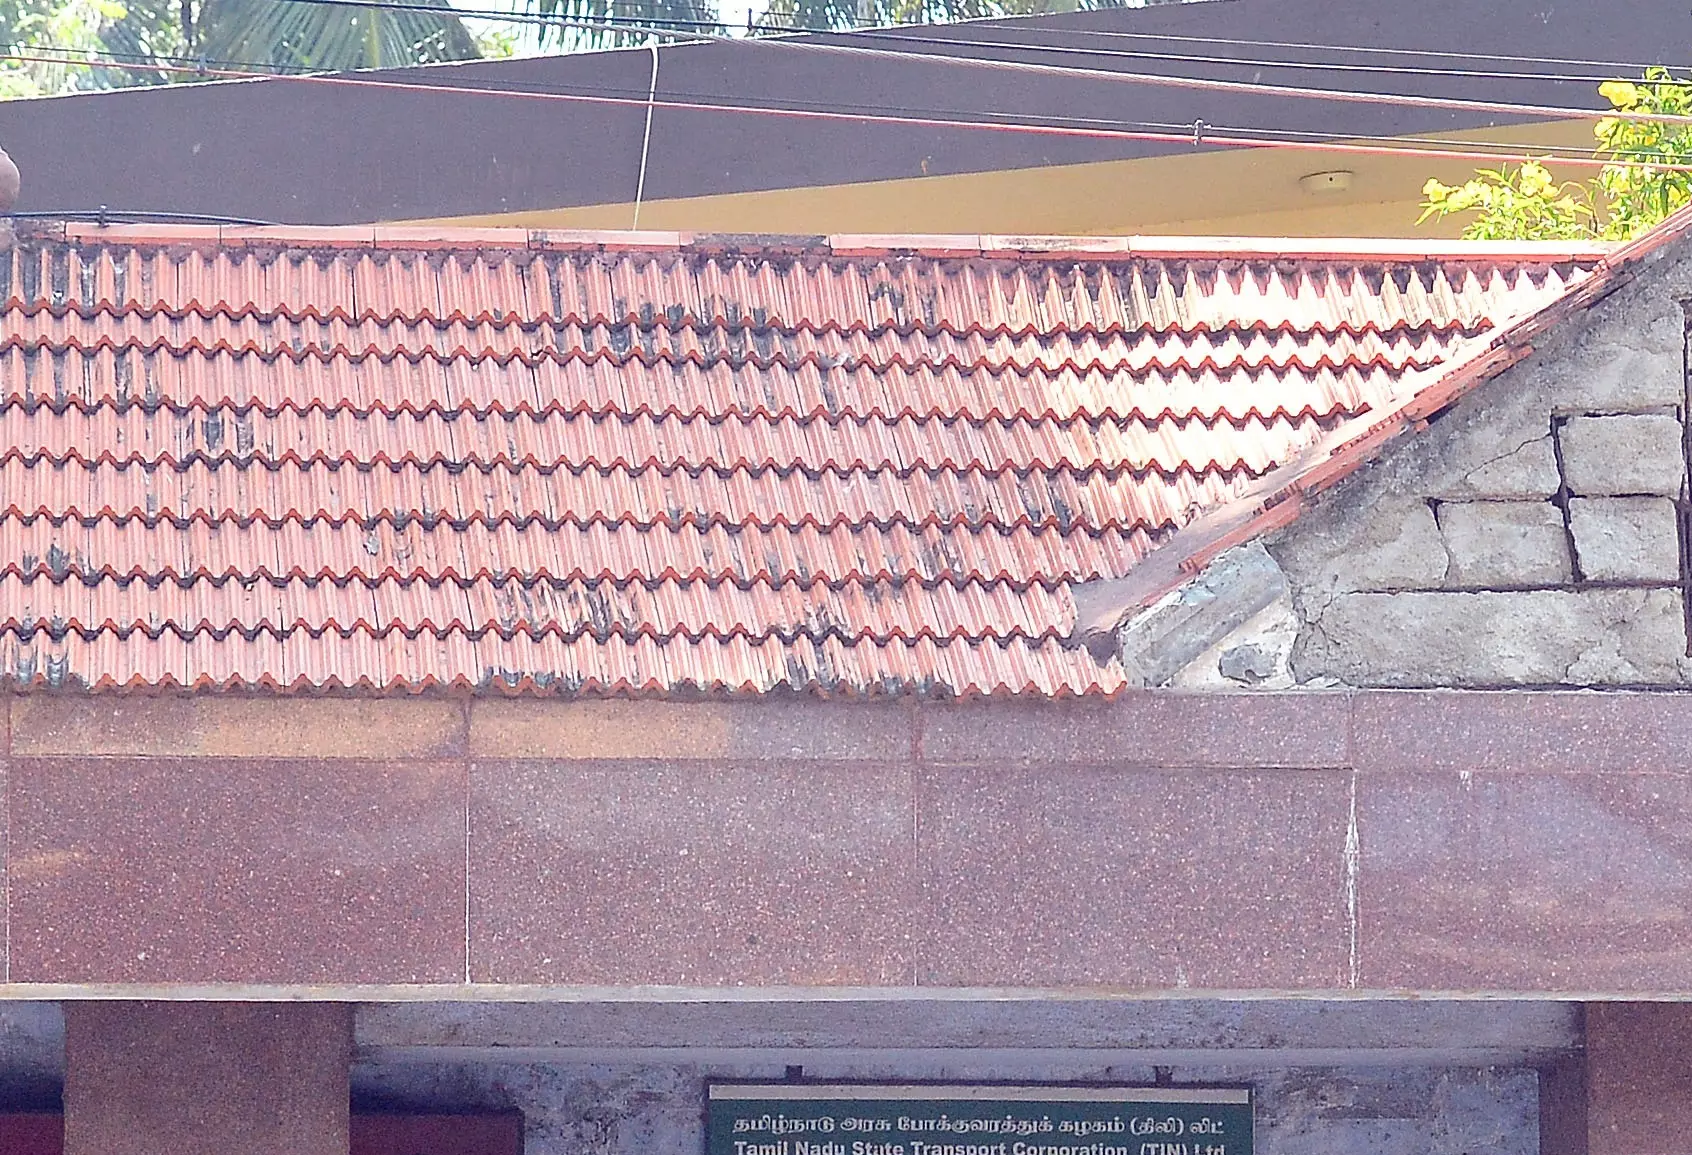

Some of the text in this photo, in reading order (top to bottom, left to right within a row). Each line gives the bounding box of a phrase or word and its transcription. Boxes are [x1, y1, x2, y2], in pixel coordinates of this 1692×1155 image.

[733, 1117, 834, 1134] தமிழ்நாடு
[840, 1118, 891, 1133] அரசு
[898, 1116, 1052, 1135] போக்குவரத்துக்
[1058, 1117, 1124, 1134] கழகம்
[1190, 1117, 1224, 1133] லிட்
